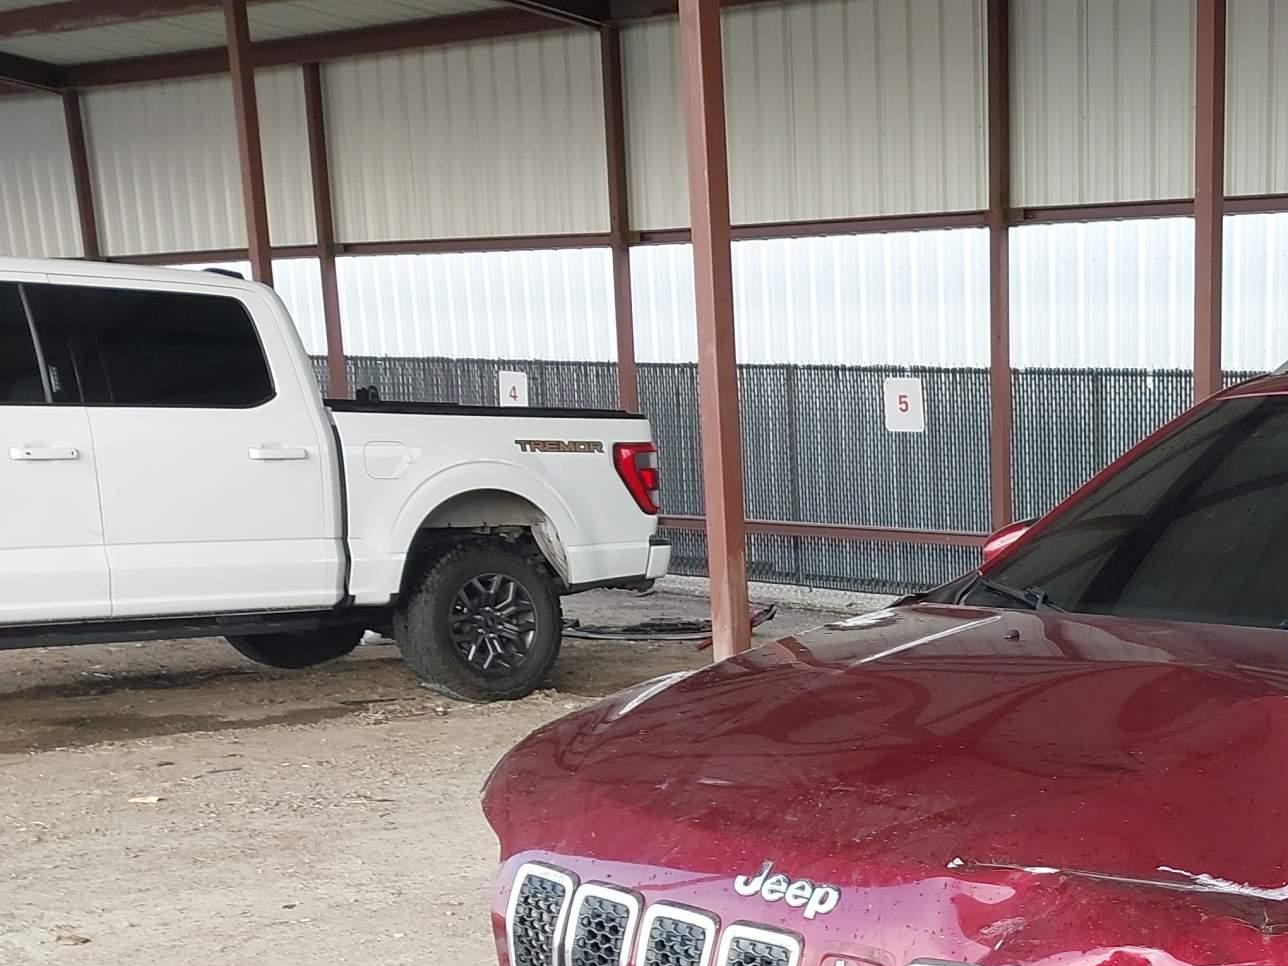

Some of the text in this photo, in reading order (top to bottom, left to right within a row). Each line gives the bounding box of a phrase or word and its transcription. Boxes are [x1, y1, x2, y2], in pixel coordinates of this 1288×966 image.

[509, 385, 518, 402] 4
[898, 394, 909, 413] 5
[514, 439, 605, 453] TREMOR
[734, 859, 841, 920] Jeep
